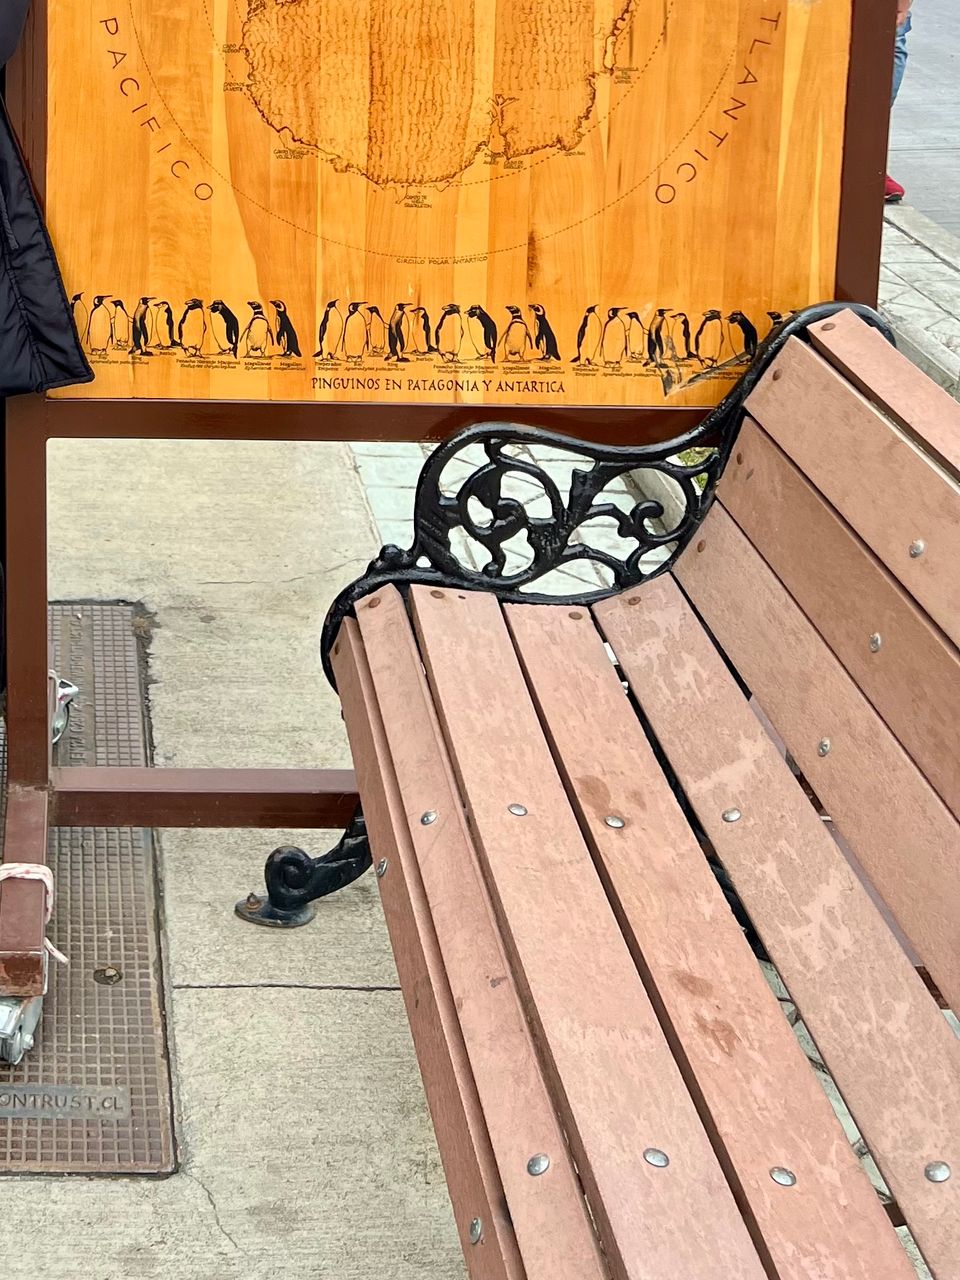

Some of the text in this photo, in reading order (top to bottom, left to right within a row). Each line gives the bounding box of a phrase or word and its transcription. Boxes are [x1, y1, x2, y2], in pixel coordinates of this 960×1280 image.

[99, 16, 214, 201] PACIFICO
[396, 257, 426, 265] CIRCULO
[311, 377, 566, 393] PINGUINOS EN PATAGONIA Y ANTARTICA
